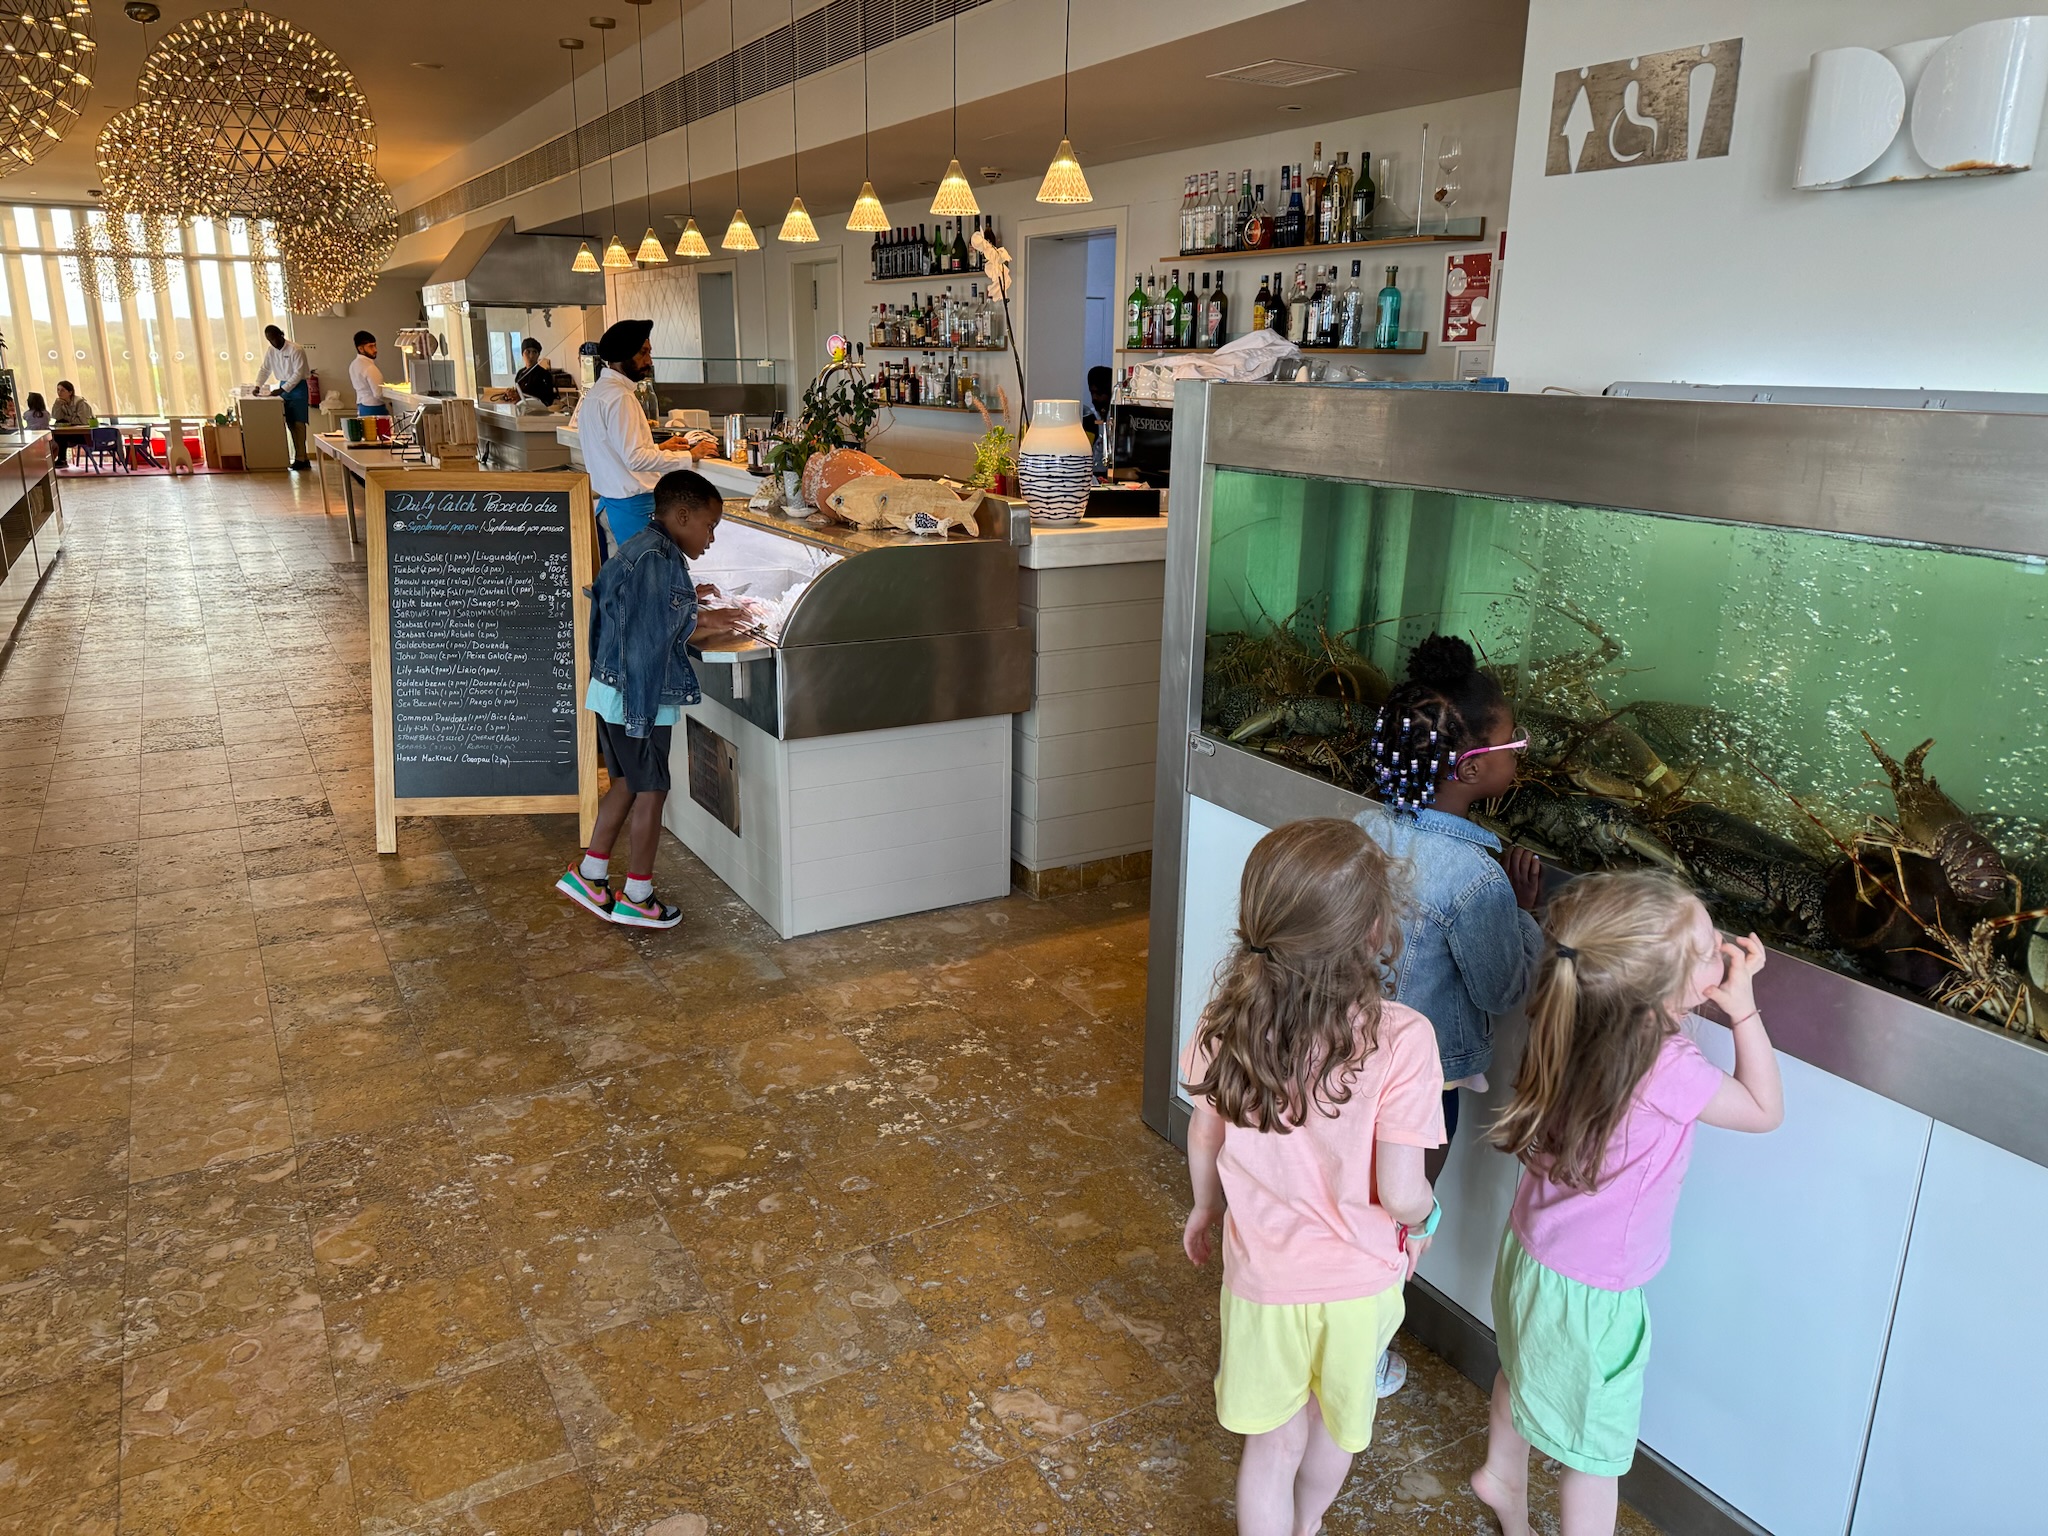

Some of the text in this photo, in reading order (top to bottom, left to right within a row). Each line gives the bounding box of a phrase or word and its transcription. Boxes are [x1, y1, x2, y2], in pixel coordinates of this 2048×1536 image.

[391, 491, 557, 520] Daily Catch Peixe do dia
